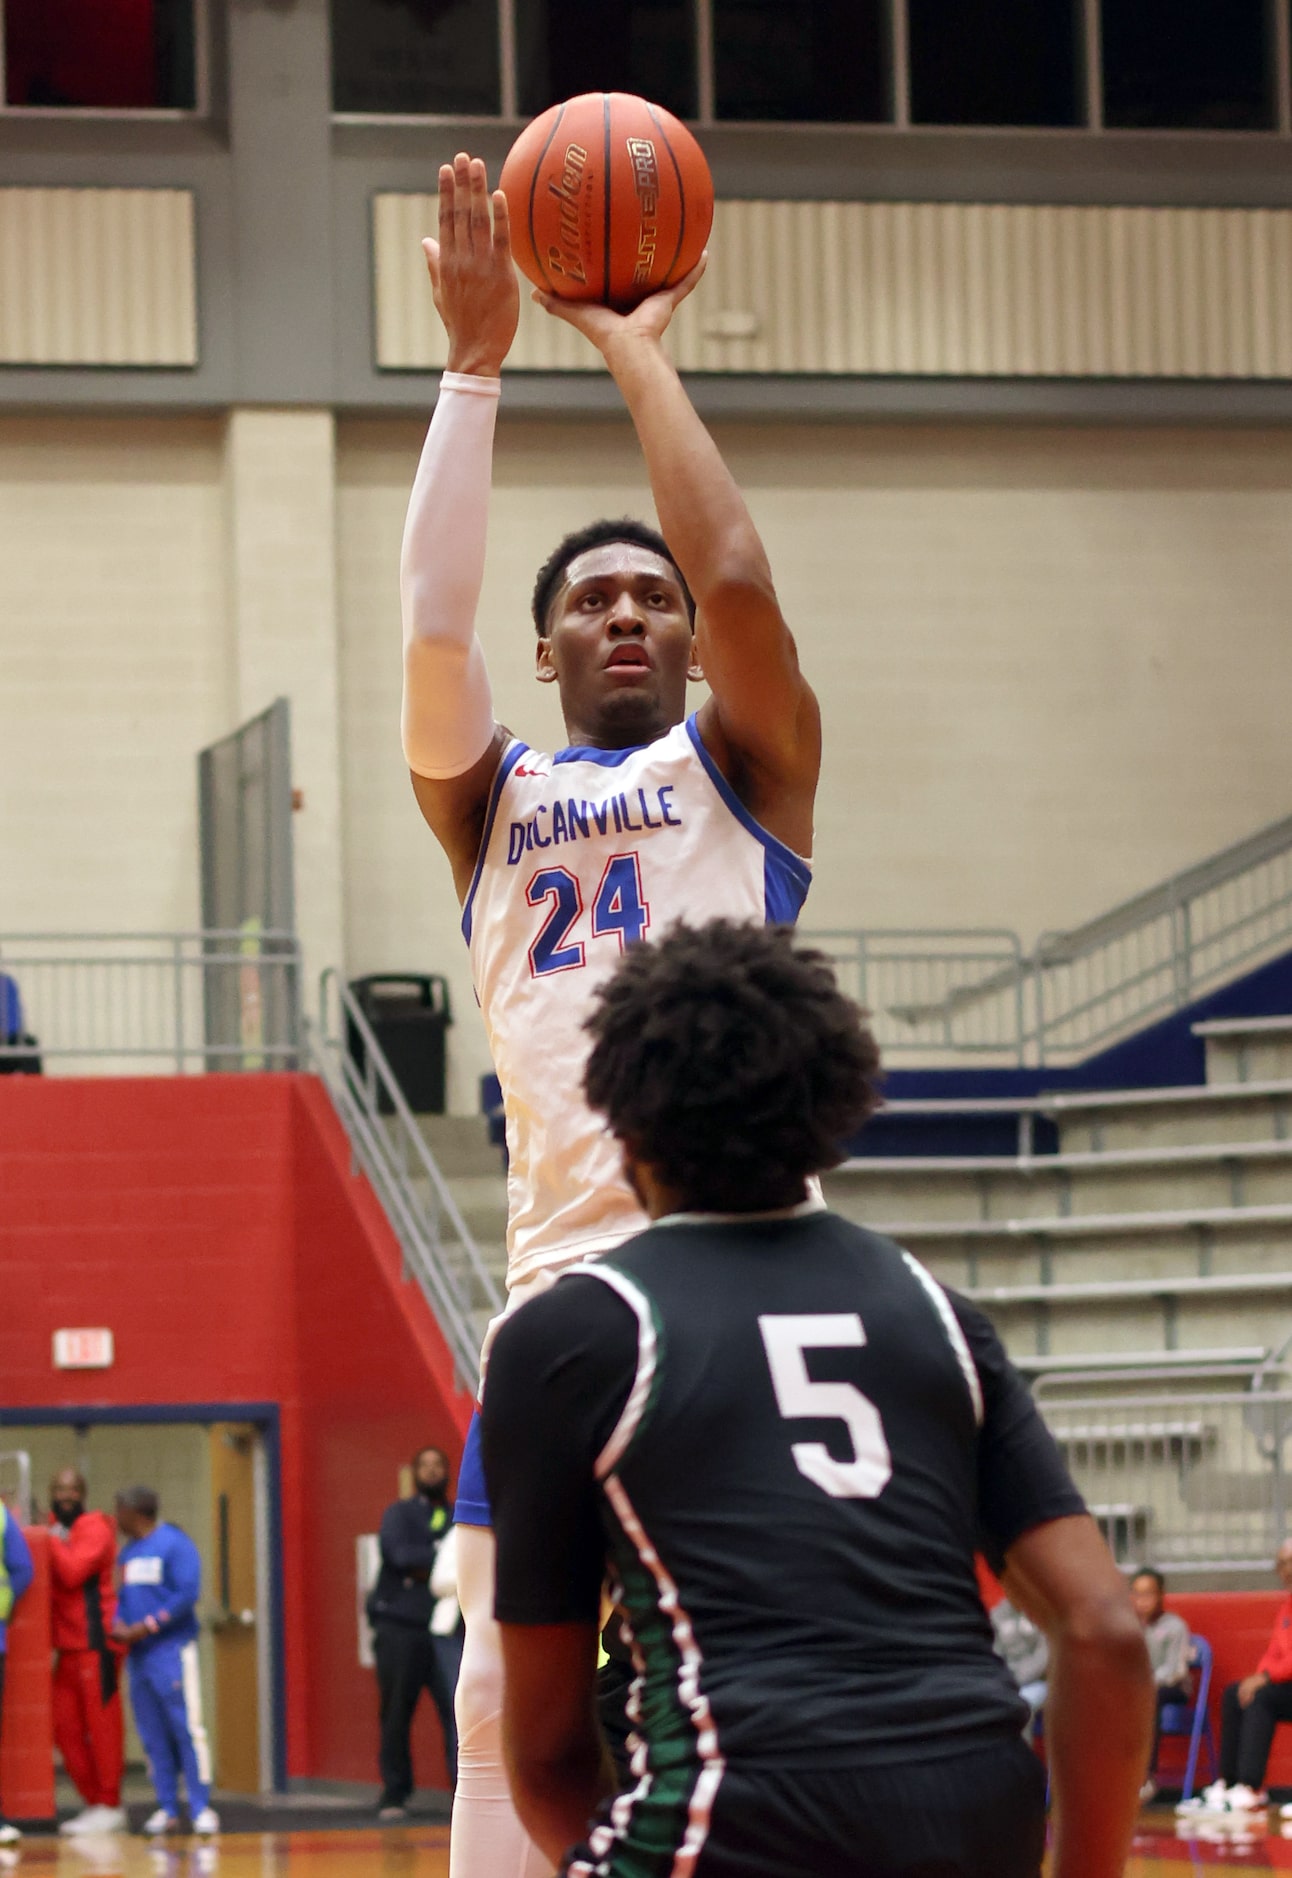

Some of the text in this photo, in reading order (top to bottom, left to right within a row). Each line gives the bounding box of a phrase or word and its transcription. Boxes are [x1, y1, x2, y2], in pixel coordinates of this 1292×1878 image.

[548, 143, 588, 285] Baden
[630, 142, 657, 188] PRO
[525, 851, 650, 979] 24
[758, 1312, 893, 1498] 5
